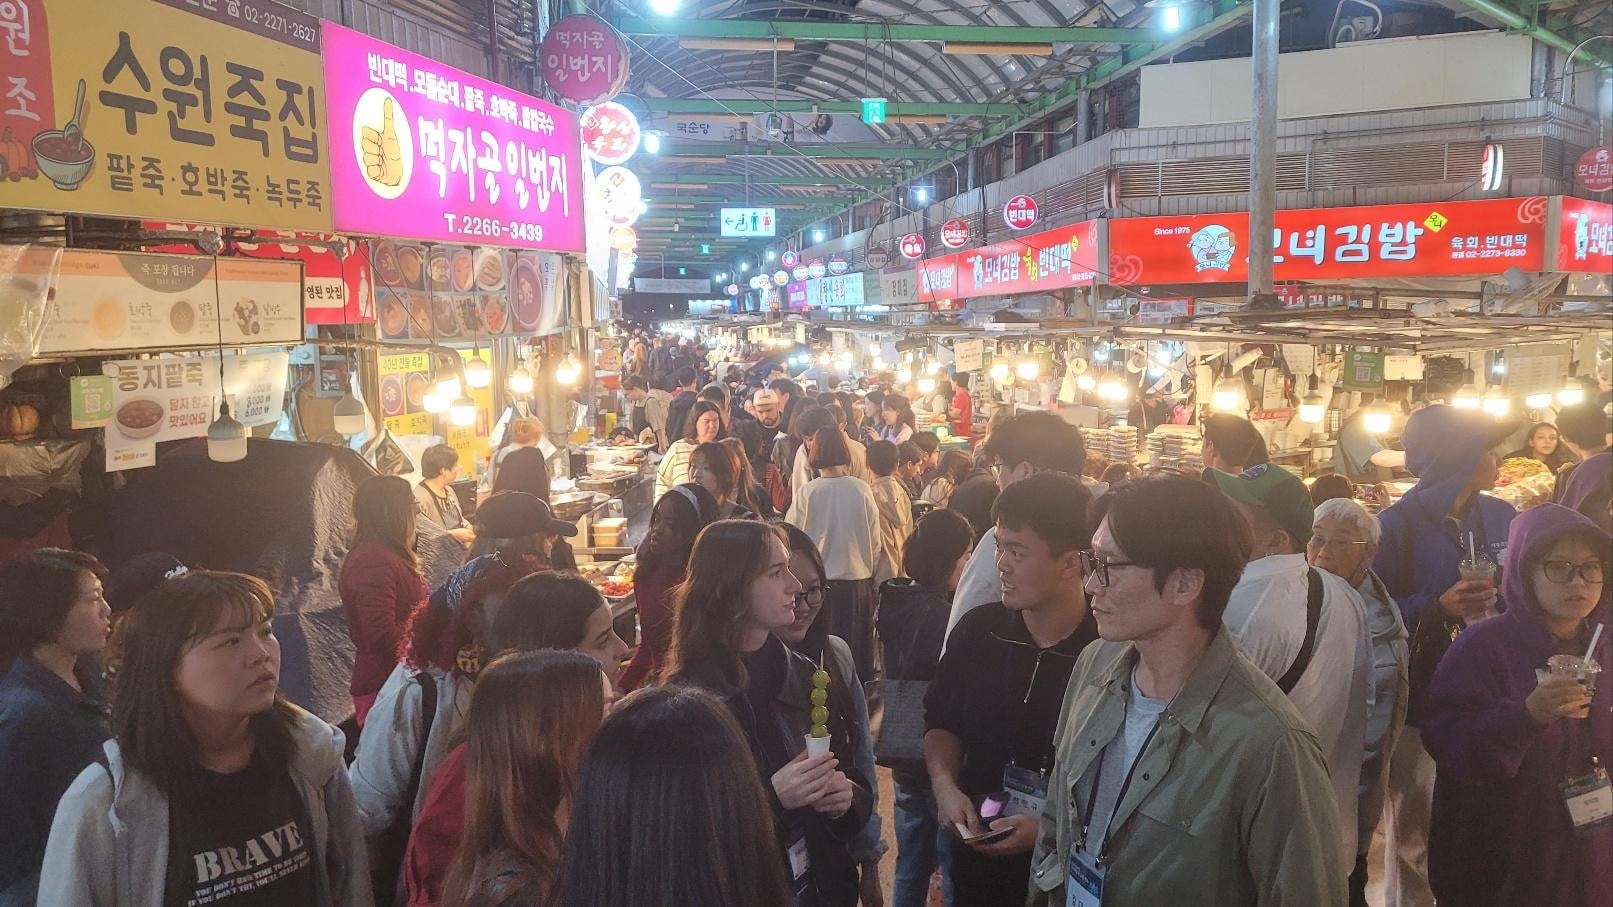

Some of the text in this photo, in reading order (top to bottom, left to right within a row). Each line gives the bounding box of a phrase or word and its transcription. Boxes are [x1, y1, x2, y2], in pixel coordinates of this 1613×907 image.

[556, 31, 605, 50] 먹자골
[547, 54, 612, 82] 일번지
[99, 31, 319, 164] 수원죽집
[676, 122, 710, 135] 국순당
[1578, 163, 1613, 176] 모녀김
[1009, 209, 1035, 222] 빈대떡
[1174, 226, 1191, 234] 1975
[1466, 249, 1526, 258] 02-2273-8330
[985, 251, 1020, 283] 모녀김밥
[1039, 242, 1072, 277] 빈대떡
[326, 285, 343, 299] 맛집
[117, 362, 203, 392] 동지팥죽
[169, 414, 208, 428] 맛있어요
[193, 821, 304, 884] BRAVE
